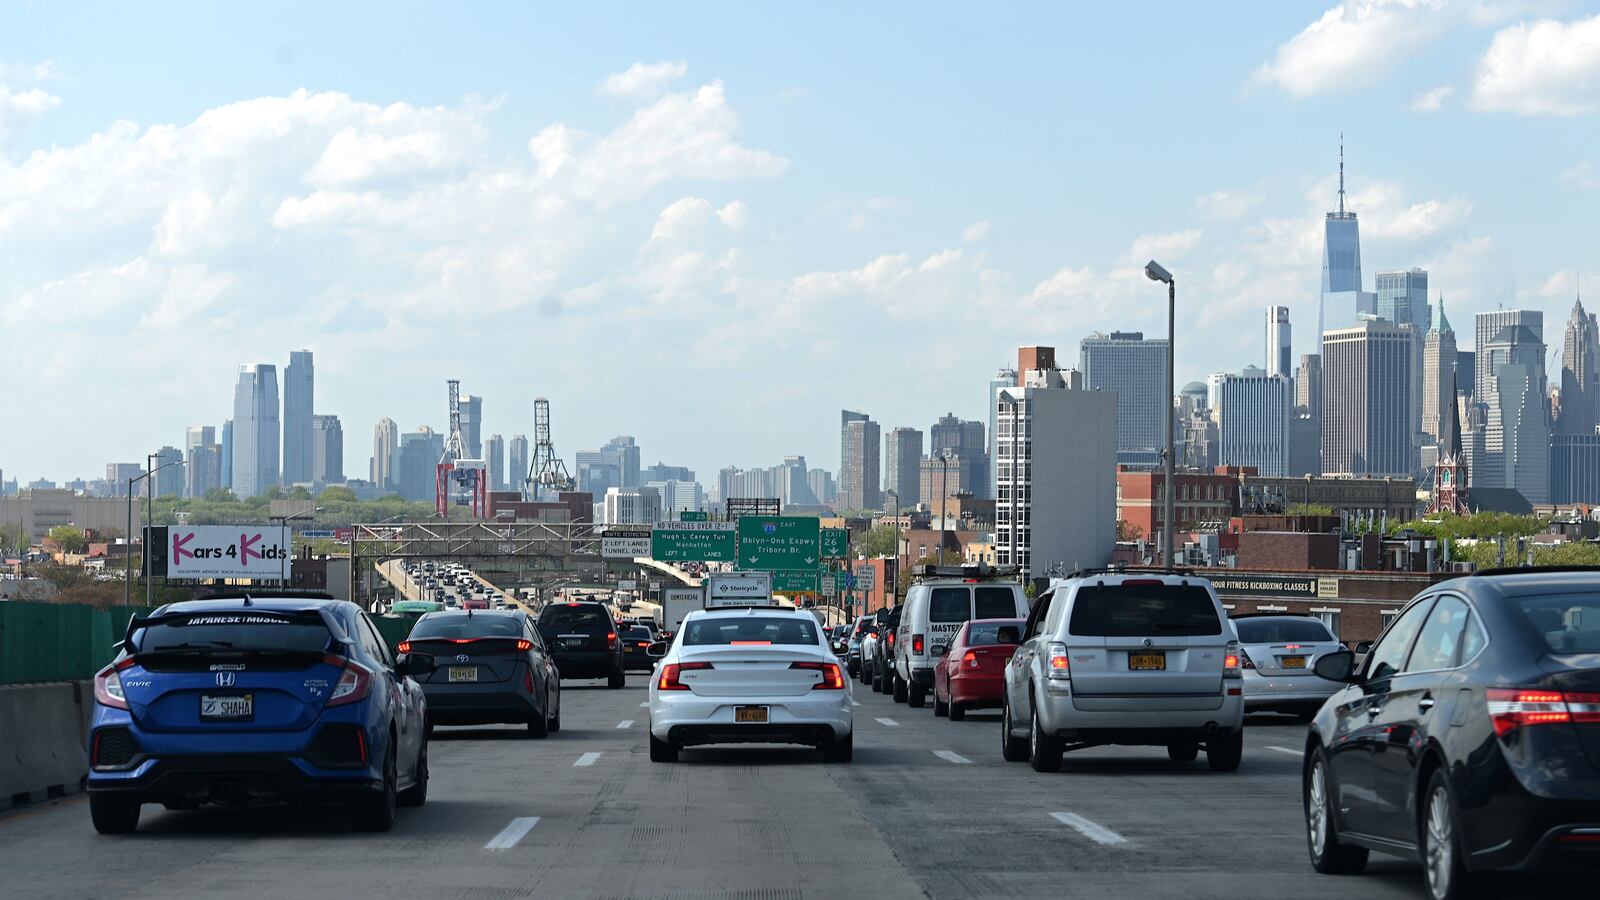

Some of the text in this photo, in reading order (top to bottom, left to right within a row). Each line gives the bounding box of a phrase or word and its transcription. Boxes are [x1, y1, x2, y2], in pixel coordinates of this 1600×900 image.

[789, 538, 815, 546] Expwy
[824, 538, 837, 546] 26
[173, 532, 287, 567] Kars 4 Kids
[1211, 580, 1309, 592] HOUR FITNESS KICKBOXING CLASSES
[187, 616, 241, 626] JAPANESE
[220, 701, 250, 715] SHAHA
